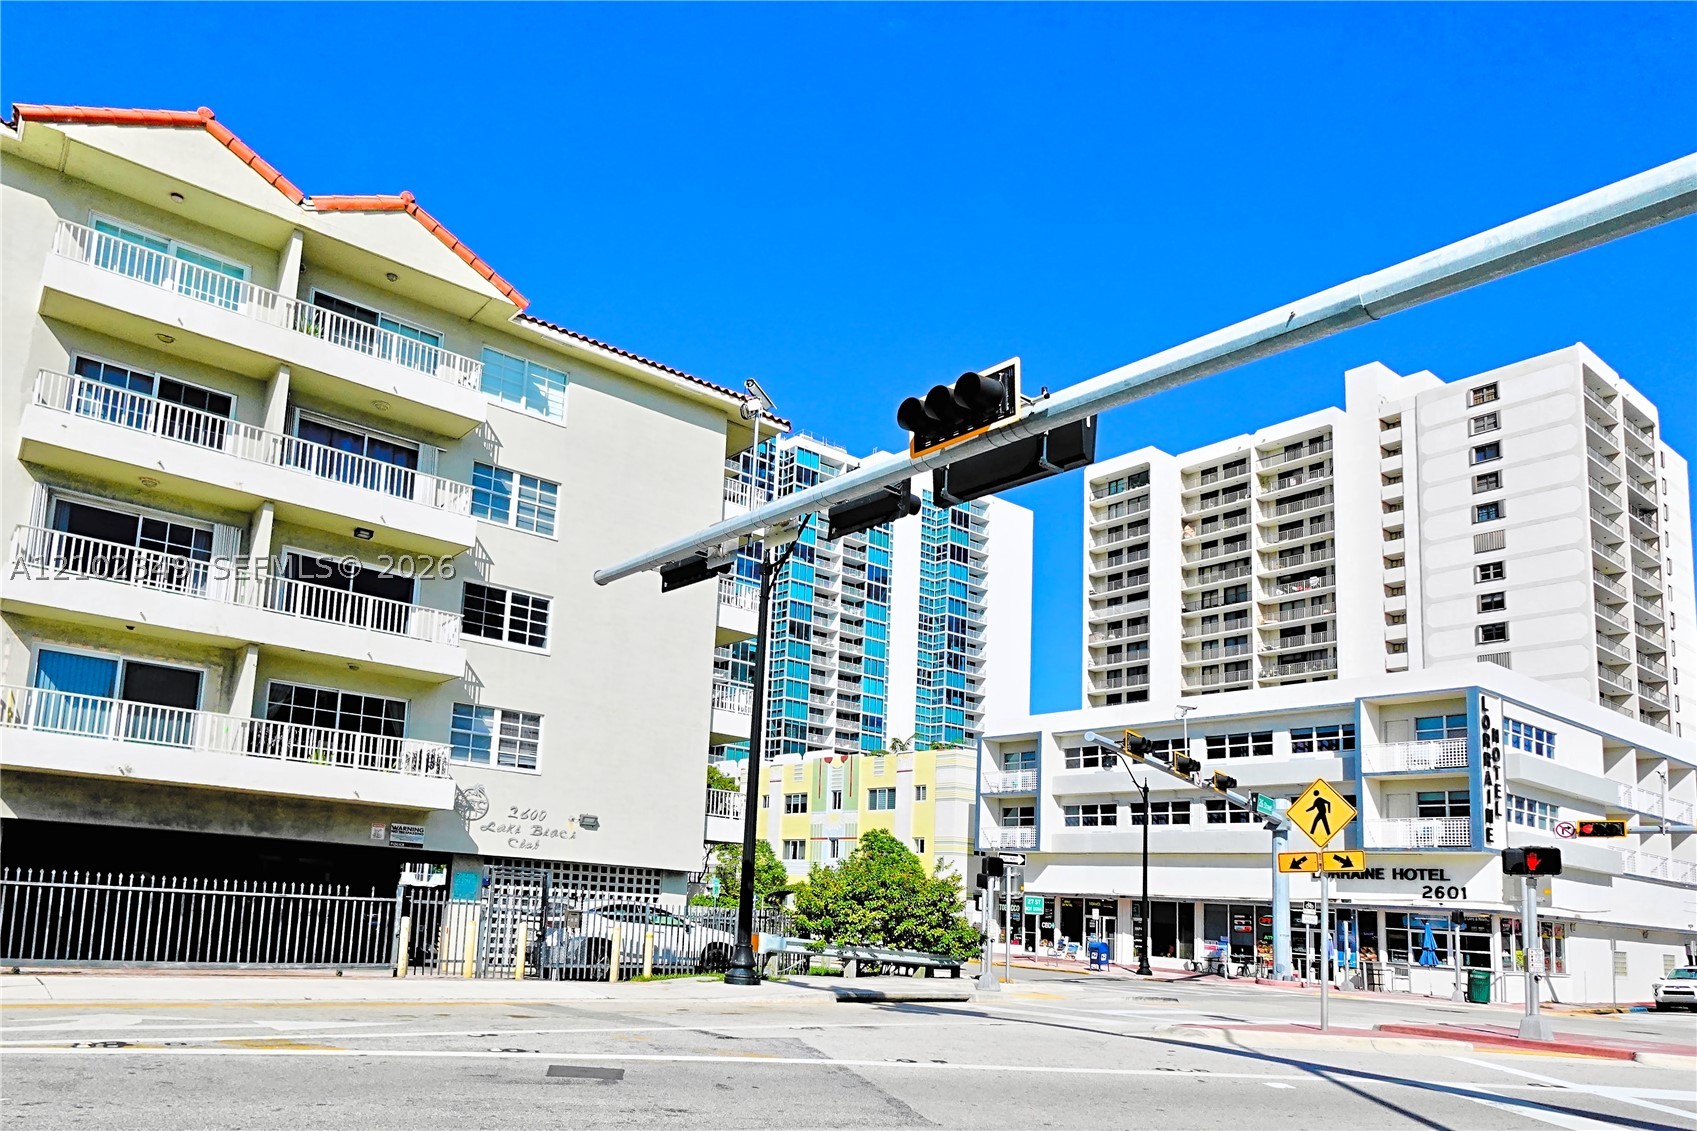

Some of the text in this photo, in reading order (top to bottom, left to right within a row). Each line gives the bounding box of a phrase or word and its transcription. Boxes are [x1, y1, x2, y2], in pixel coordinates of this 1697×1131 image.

[1481, 696, 1494, 843] LORRAINE
[1491, 727, 1502, 817] HOTEL
[507, 806, 547, 821] 2600
[391, 825, 424, 833] WARNING
[1312, 867, 1451, 882] LRRAINE HOTEL
[1422, 886, 1467, 899] 2601
